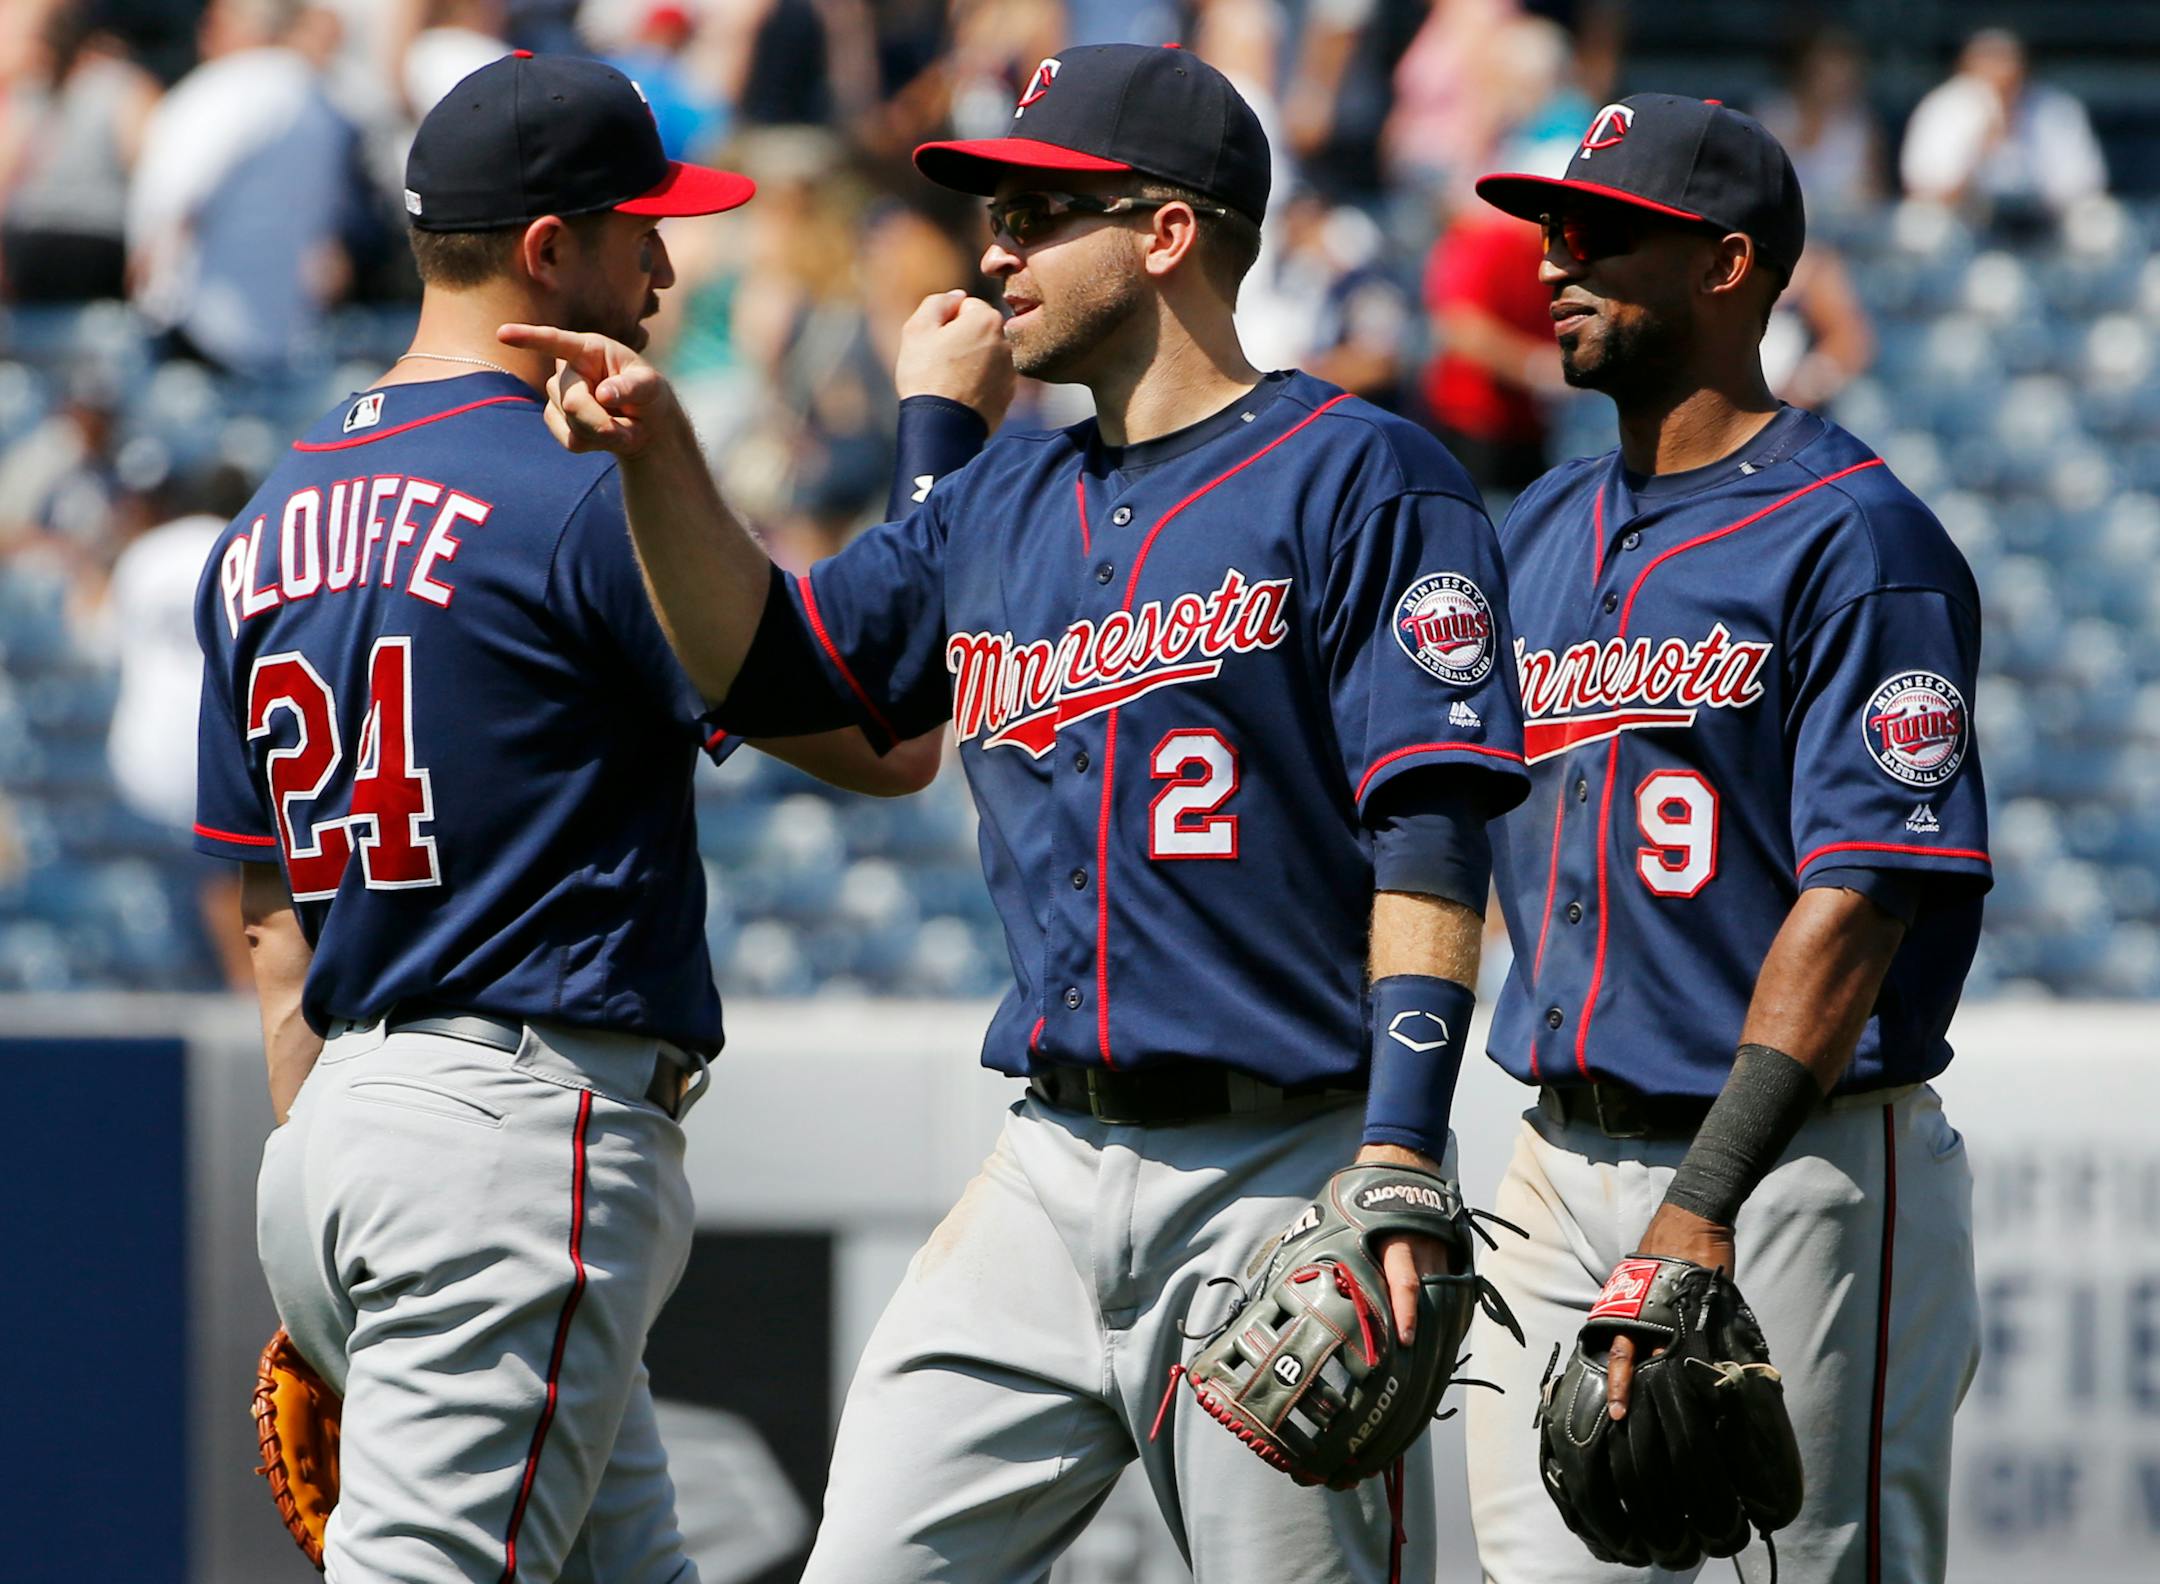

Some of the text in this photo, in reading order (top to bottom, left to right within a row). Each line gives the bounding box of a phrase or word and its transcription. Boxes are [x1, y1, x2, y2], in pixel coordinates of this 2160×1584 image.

[220, 474, 493, 640] PLOUFFE
[1402, 577, 1486, 613] MINNESOTA
[1401, 606, 1489, 649] Twins
[946, 567, 1293, 747] Minnesota
[1416, 650, 1472, 682] BASEBALL
[1471, 655, 1491, 679] CLUB
[1513, 622, 1774, 719] nnesota
[1873, 676, 1960, 711] MINNESOTA
[1870, 705, 1961, 750] Twins
[247, 635, 441, 902] 24
[1880, 751, 1938, 782] BASEBALL
[1938, 753, 1961, 777] CLUB
[1149, 728, 1240, 860] 2
[1635, 769, 1720, 899] 9
[1363, 1185, 1444, 1212] Wilson
[1349, 1375, 1399, 1454] A2000
